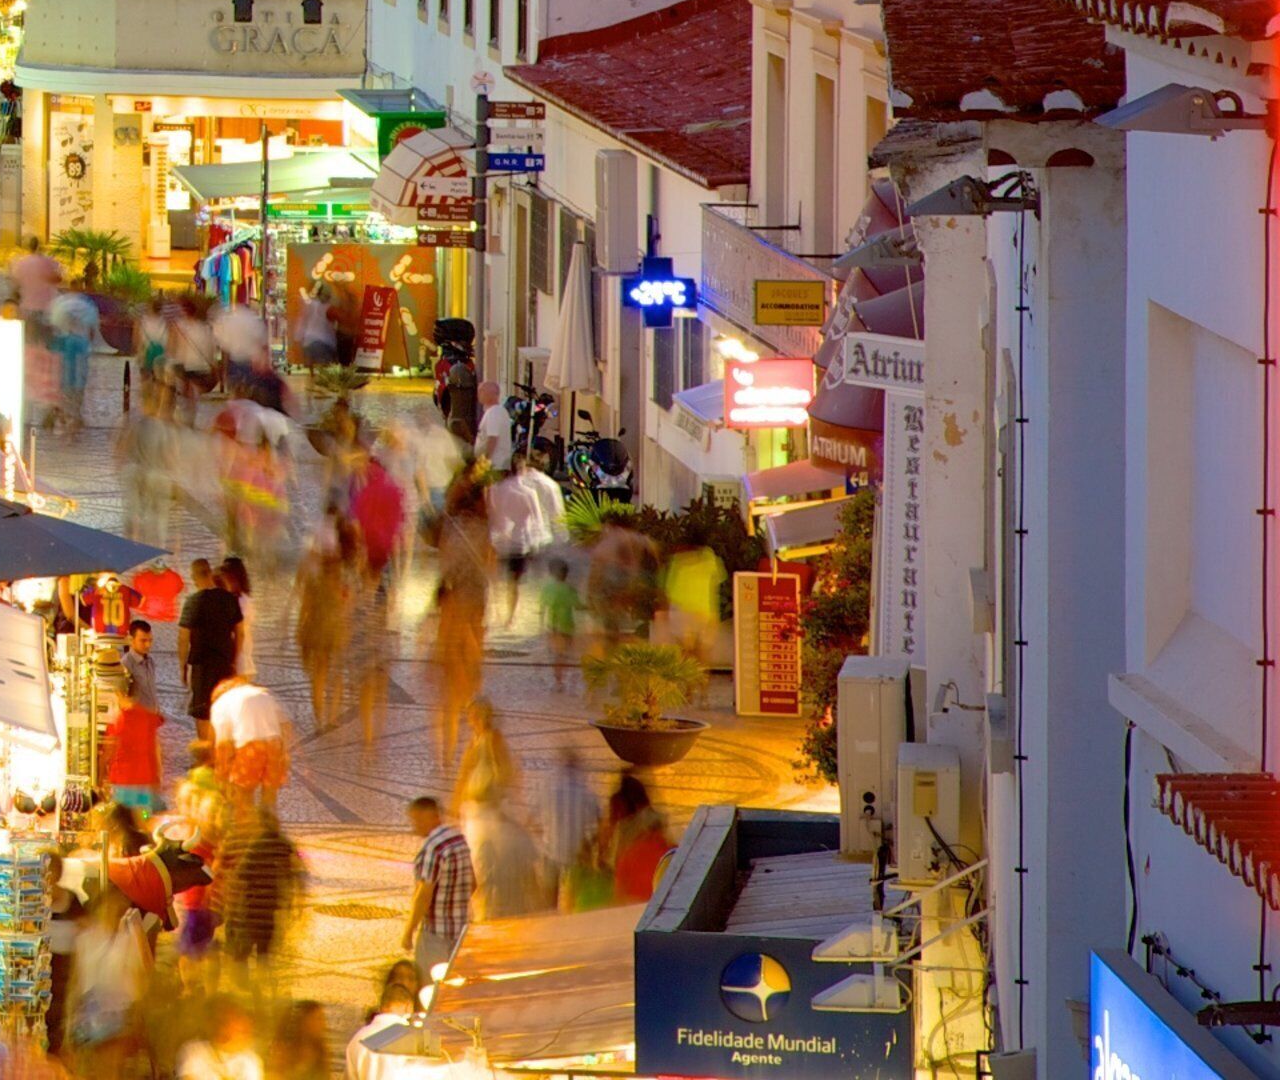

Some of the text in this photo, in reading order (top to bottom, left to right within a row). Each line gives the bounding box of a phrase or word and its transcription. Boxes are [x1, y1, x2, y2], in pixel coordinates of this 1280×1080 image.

[208, 24, 341, 60] GRAÇA
[494, 158, 519, 166] G.N.R.
[812, 435, 866, 467] ATRIUM
[901, 405, 924, 654] Restaurante
[101, 599, 125, 627] 10
[677, 1027, 836, 1054] Fidelidade Mundial
[731, 1051, 782, 1066] Agente
